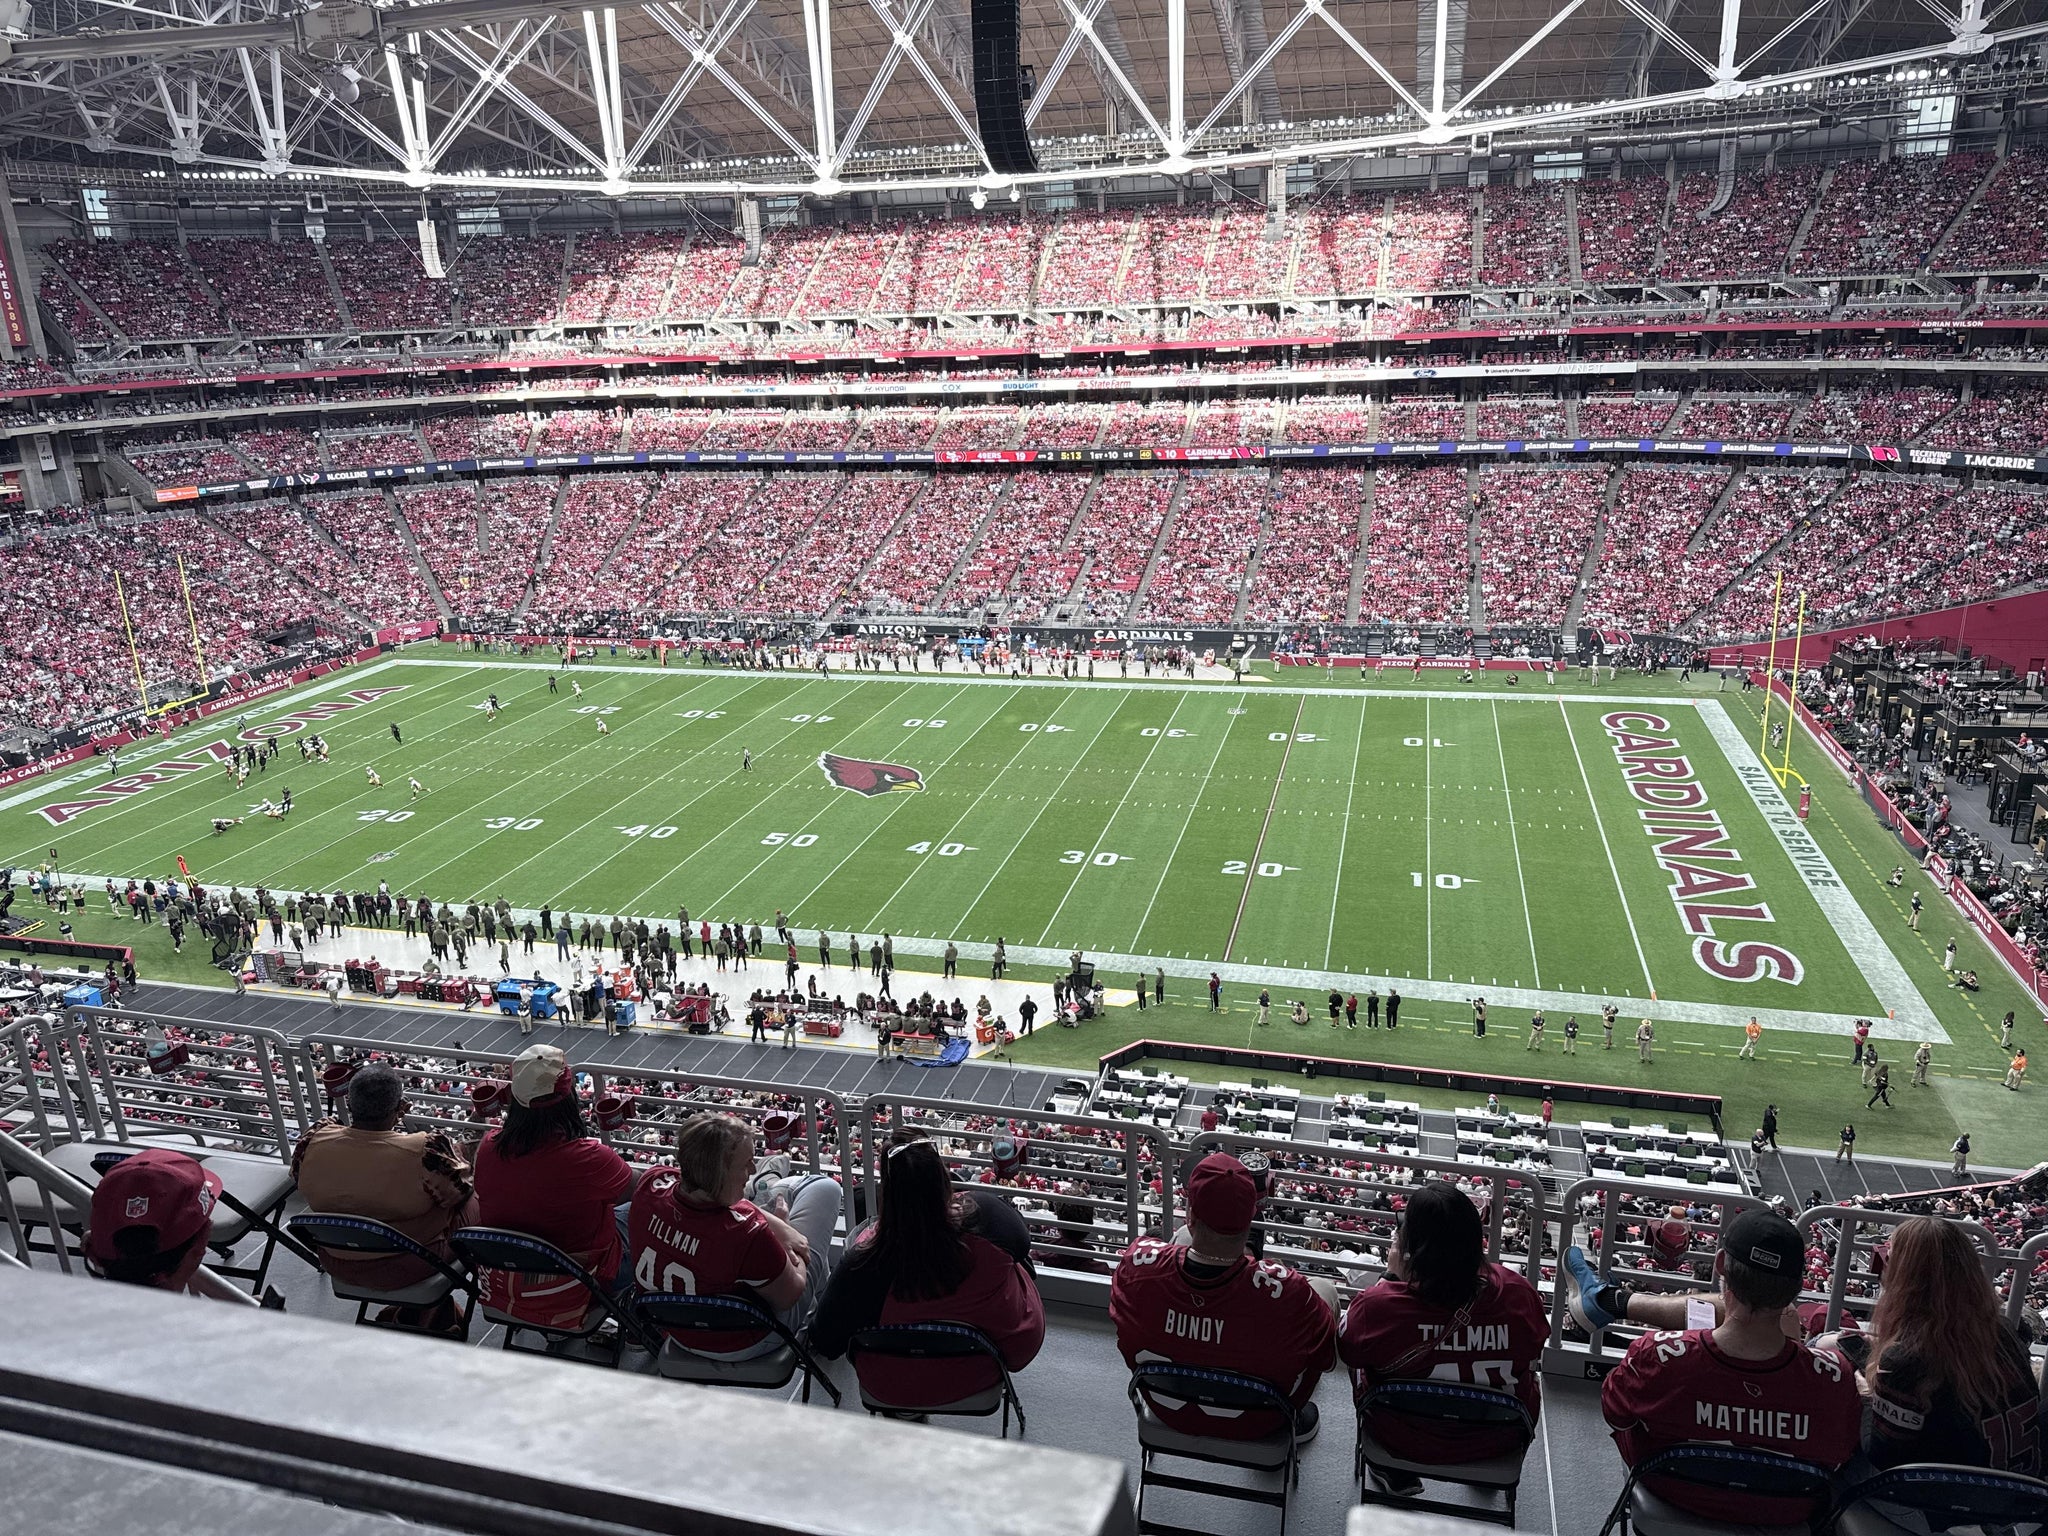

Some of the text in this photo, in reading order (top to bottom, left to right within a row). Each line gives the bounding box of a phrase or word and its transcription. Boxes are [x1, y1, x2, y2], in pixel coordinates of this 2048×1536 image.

[7, 302, 21, 341] 1898
[1952, 320, 1984, 328] WILSON
[386, 366, 413, 374] AENEAS
[1490, 367, 1509, 375] University
[1556, 365, 1603, 374] AVNET
[208, 376, 237, 384] MATSON
[1328, 446, 1375, 455] planet fitness
[1416, 444, 1440, 452] fitness
[1457, 443, 1506, 452] planet fitness
[1525, 442, 1548, 451] planet
[1589, 441, 1640, 450] planet fitness
[1654, 442, 1706, 451] planet fitness
[1722, 444, 1775, 453] planet fitness
[1792, 445, 1848, 455] planet fitness
[1015, 452, 1026, 461] 19
[1047, 452, 1054, 460] 2
[1060, 451, 1082, 460] 5:13
[1090, 450, 1103, 459] 1ST
[1108, 450, 1118, 459] 10
[1165, 450, 1177, 458] 10
[1185, 448, 1233, 456] CARDINALS
[1269, 448, 1292, 456] planet
[1909, 450, 1951, 459] RECEIVING
[482, 460, 502, 468] planet
[537, 458, 557, 466] planet
[593, 455, 613, 463] planet
[1912, 456, 1947, 465] LEADERS
[1964, 454, 2035, 470] T.MCBRIDE
[326, 471, 368, 481] N.COLLINS
[1094, 630, 1194, 641] CARDINALS
[1376, 660, 1415, 668] RIZONA
[210, 679, 289, 711] ARIZONA CARDINALS
[682, 710, 727, 719] 30
[790, 714, 836, 723] 40
[77, 721, 113, 736] ARIZONA
[902, 719, 948, 728] 50
[1019, 723, 1066, 733] 40
[1140, 728, 1188, 737] 30
[1268, 733, 1318, 743] 20
[1403, 737, 1444, 747] 10
[27, 684, 415, 827] ARIZONA
[17, 753, 75, 779] CARDNALS
[356, 810, 415, 822] 20
[485, 817, 544, 830] 30
[1738, 765, 1840, 888] SALUTE TO SERVICE
[621, 825, 679, 838] 40
[760, 833, 819, 847] 50
[905, 842, 967, 856] 40
[1600, 711, 1805, 986] CARDINALS
[1059, 850, 1120, 866] 30
[1221, 861, 1285, 877] 20
[1410, 872, 1462, 890] 10
[1957, 888, 1992, 934] CARDINALS
[1379, 1166, 1390, 1174] 23
[648, 1213, 700, 1256] TILLMAN
[1132, 1239, 1169, 1266] 33
[635, 1246, 696, 1296] 40
[1252, 1260, 1288, 1299] 33
[1165, 1308, 1224, 1344] BUNDY
[1418, 1324, 1509, 1351] TILLMAN
[1653, 1330, 1686, 1363] 32
[1696, 1400, 1809, 1440] MATHIEU
[1981, 1396, 2041, 1477] 15
